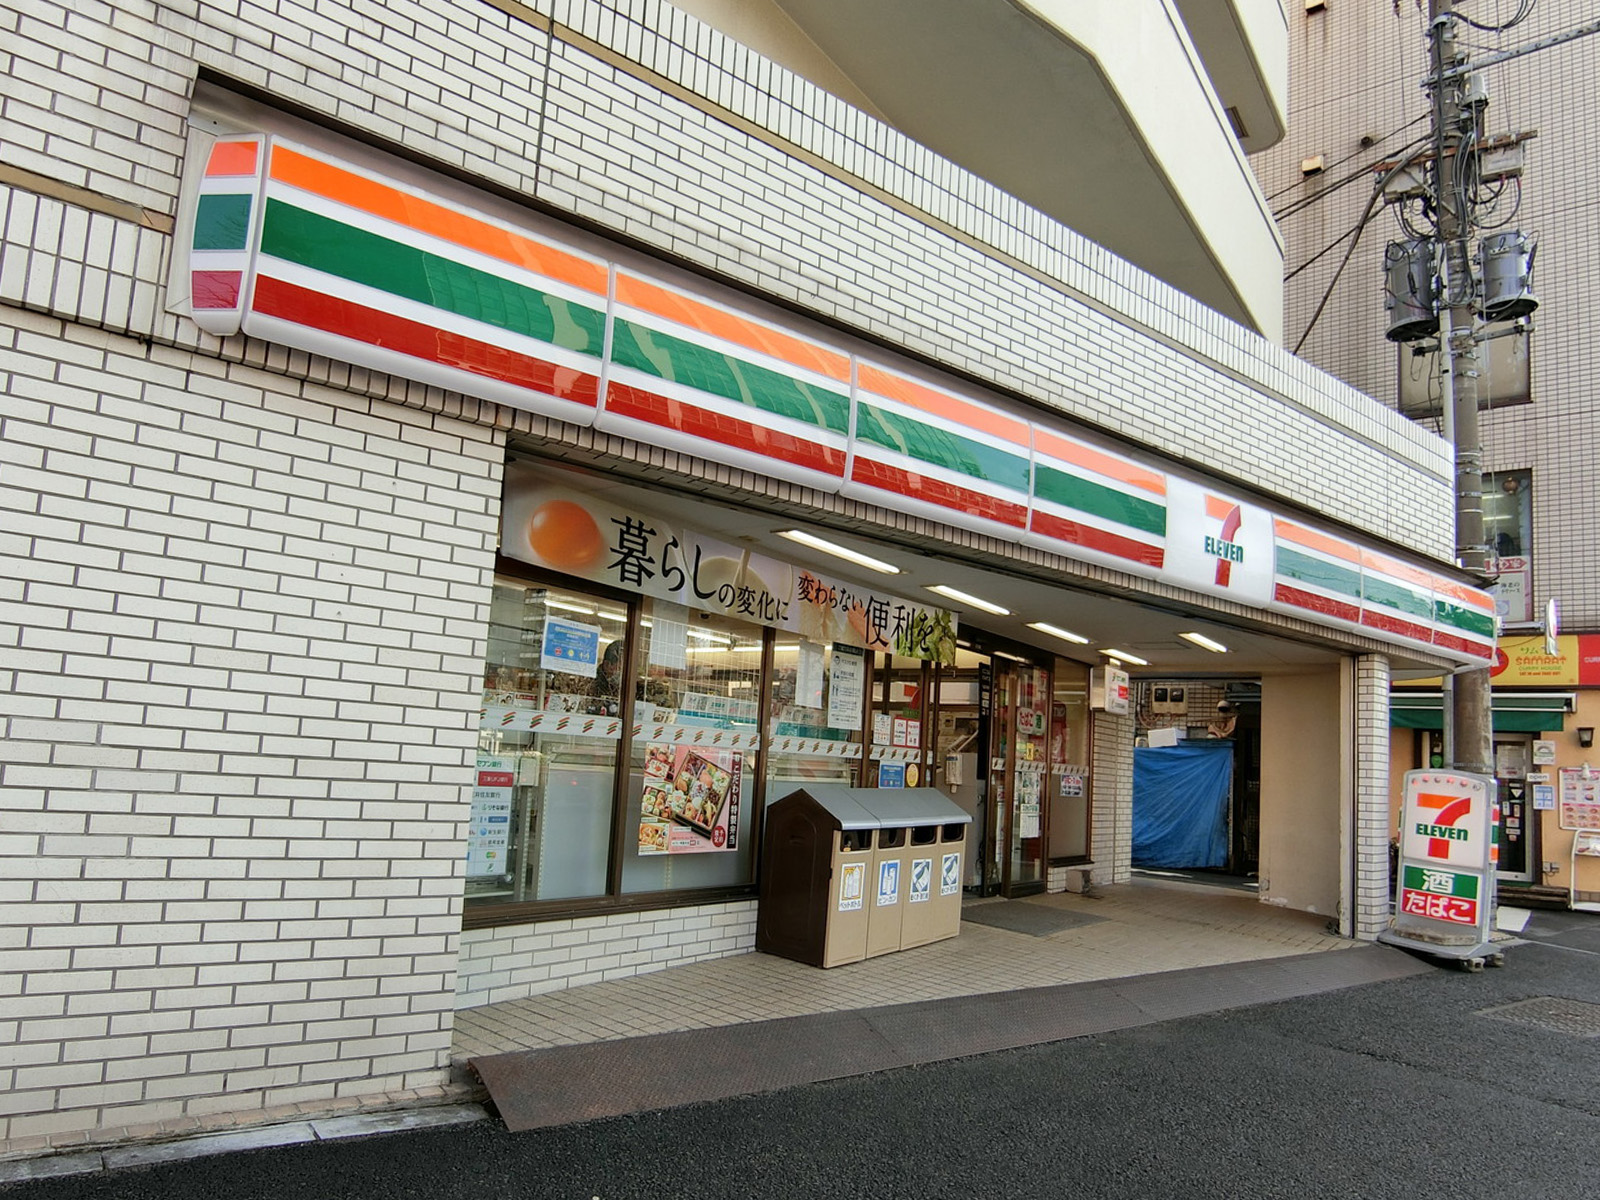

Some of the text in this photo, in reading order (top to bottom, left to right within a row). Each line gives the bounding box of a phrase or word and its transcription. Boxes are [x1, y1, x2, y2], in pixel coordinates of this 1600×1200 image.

[1204, 494, 1242, 588] 7
[607, 516, 933, 653] 暮らしの変化に 変わらない便利を
[1515, 656, 1567, 665] SAMRAT
[1417, 793, 1471, 859] 7
[1422, 869, 1455, 894] 酒
[1406, 892, 1471, 921] たばこ
